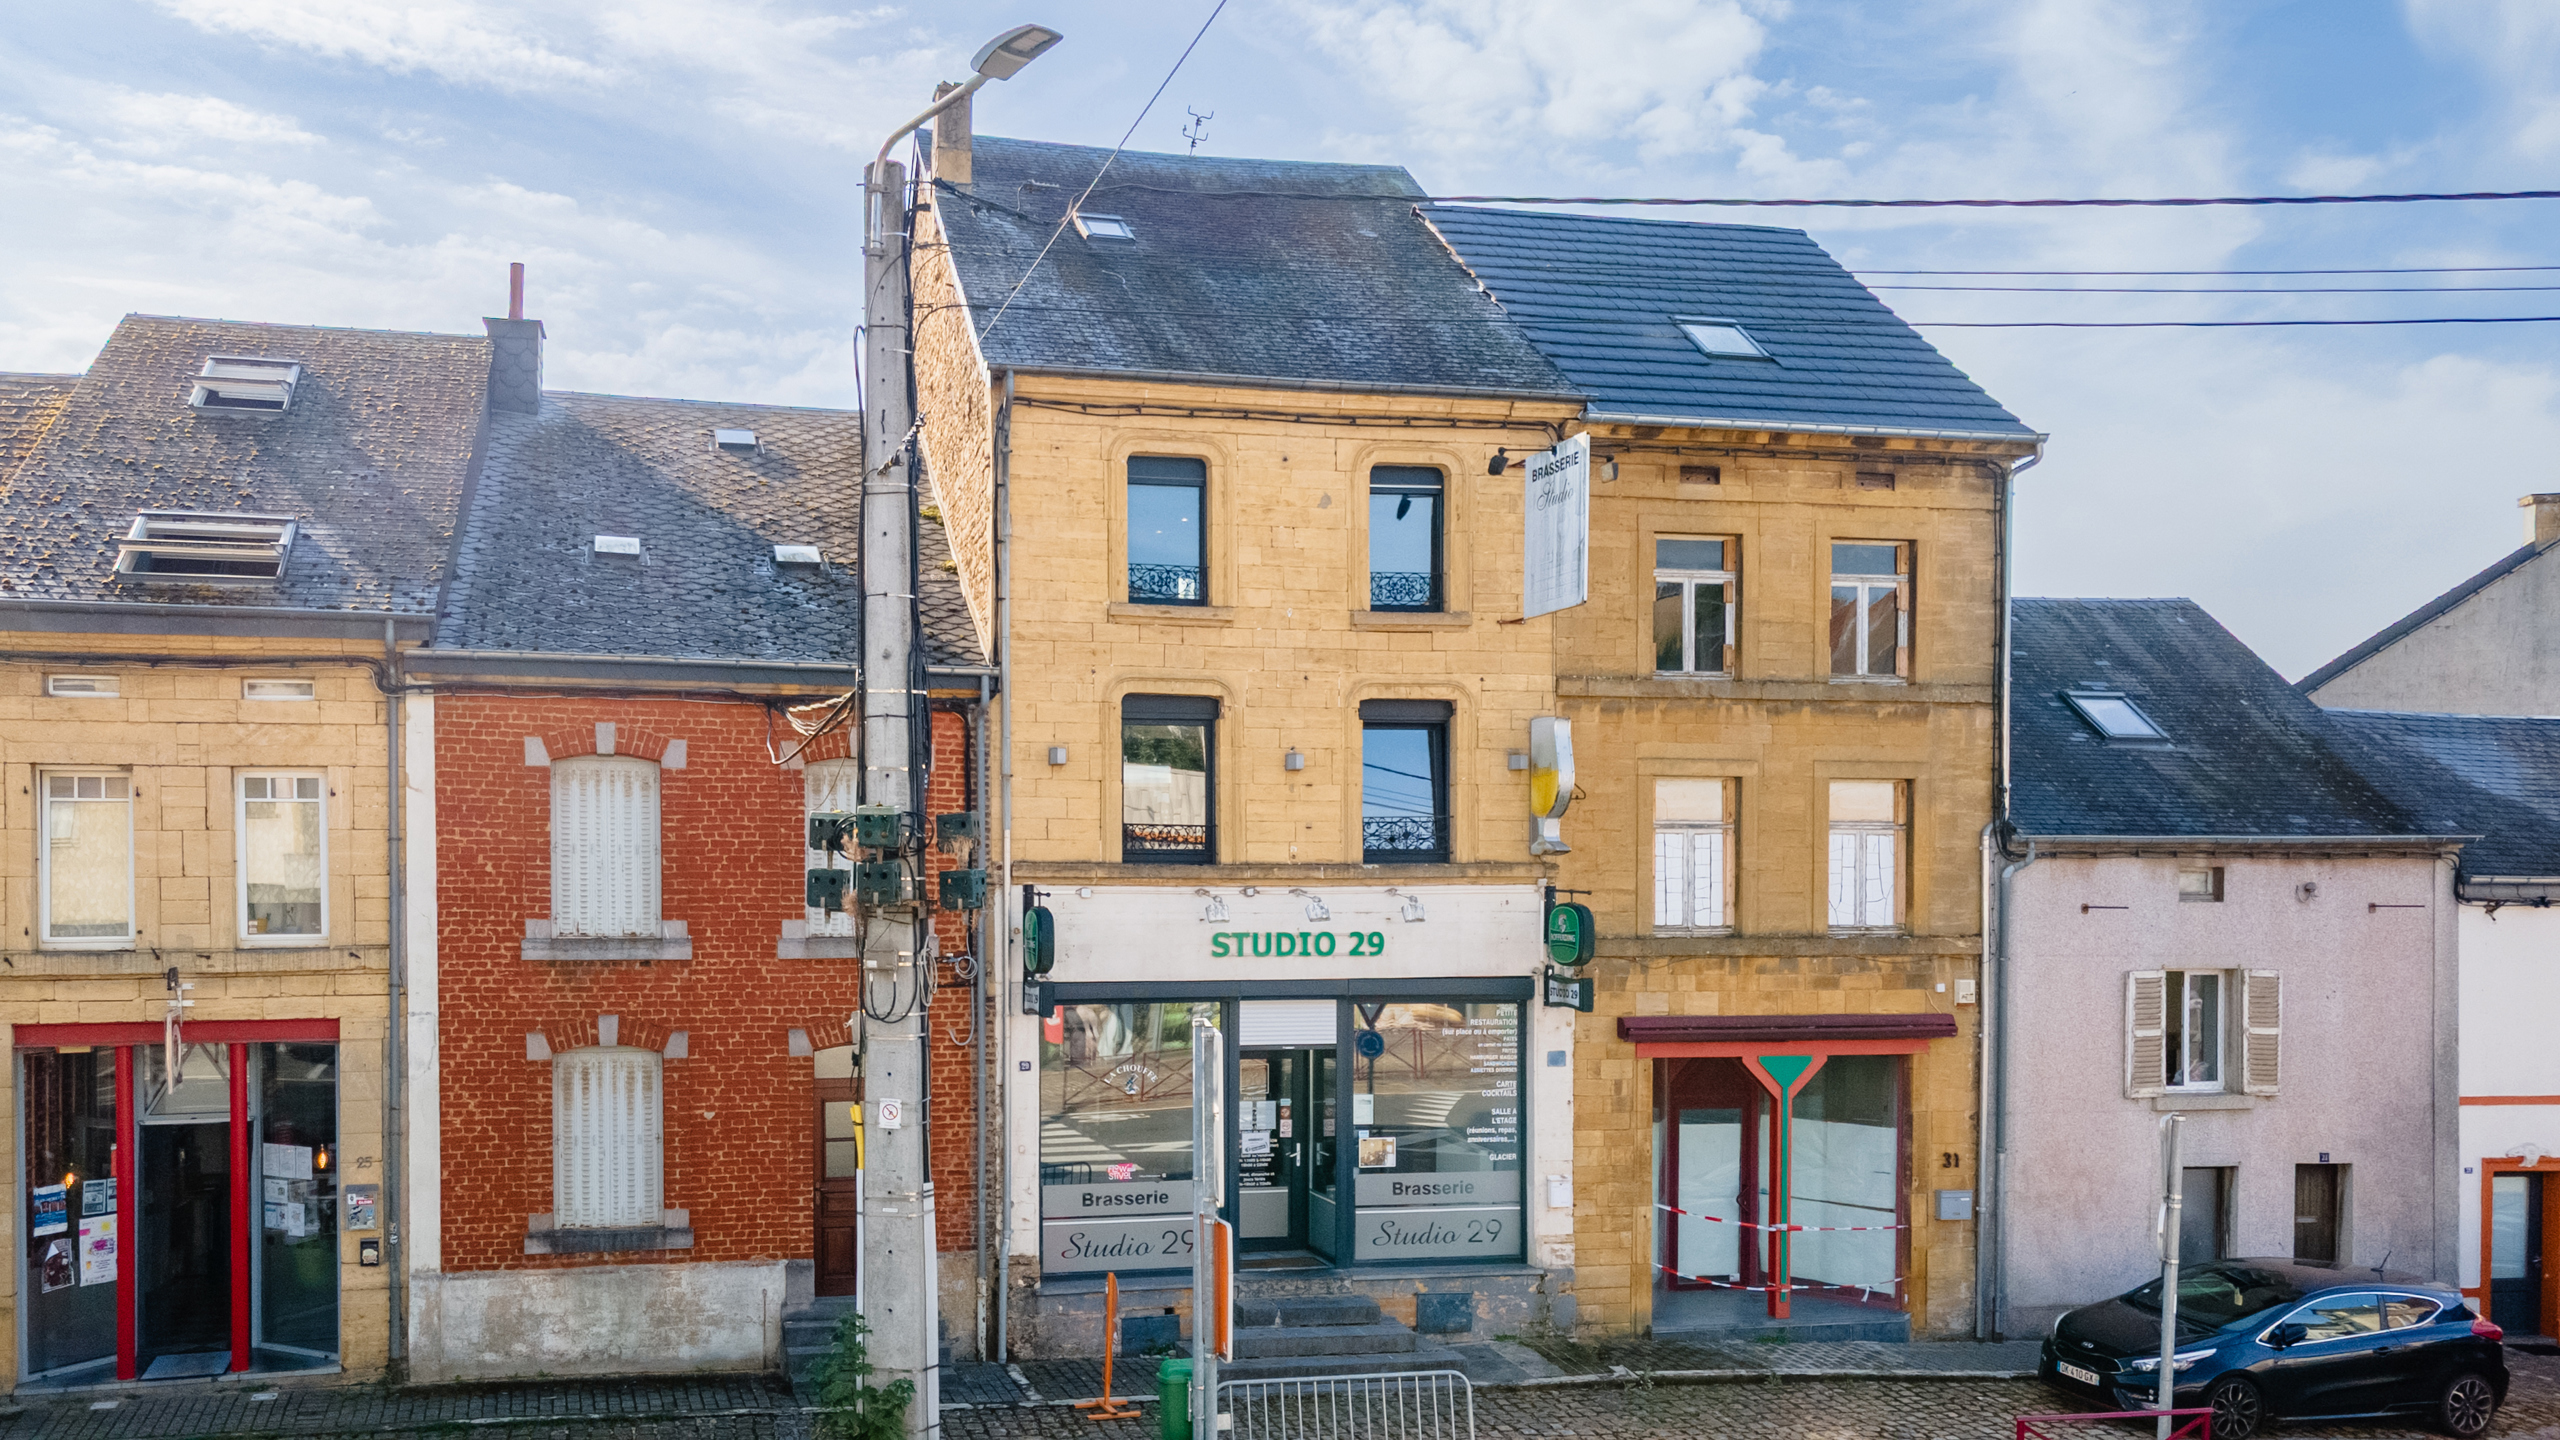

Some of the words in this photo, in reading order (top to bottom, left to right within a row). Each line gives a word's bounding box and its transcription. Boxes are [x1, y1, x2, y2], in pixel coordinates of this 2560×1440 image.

[1532, 451, 1579, 482] BRASSERIE
[1537, 479, 1574, 511] Studio
[1211, 932, 1336, 957] STUDIO
[1349, 931, 1385, 956] 29
[1470, 1018, 1518, 1026] RESTAURATION
[1103, 1072, 1117, 1085] LA
[1116, 1063, 1159, 1083] CHOUFFE
[1496, 1080, 1518, 1088] CARTE
[1481, 1089, 1518, 1097] COCKTAILS
[356, 1156, 373, 1169] 25
[1489, 1153, 1518, 1161] GLACIER
[1942, 1152, 1960, 1168] 31
[1393, 1180, 1475, 1196] Brasserie
[1081, 1190, 1169, 1207] Brasserie
[1372, 1220, 1461, 1247] Studio
[1467, 1219, 1503, 1243] 29
[1061, 1232, 1156, 1260] Studio
[1161, 1229, 1194, 1255] 29
